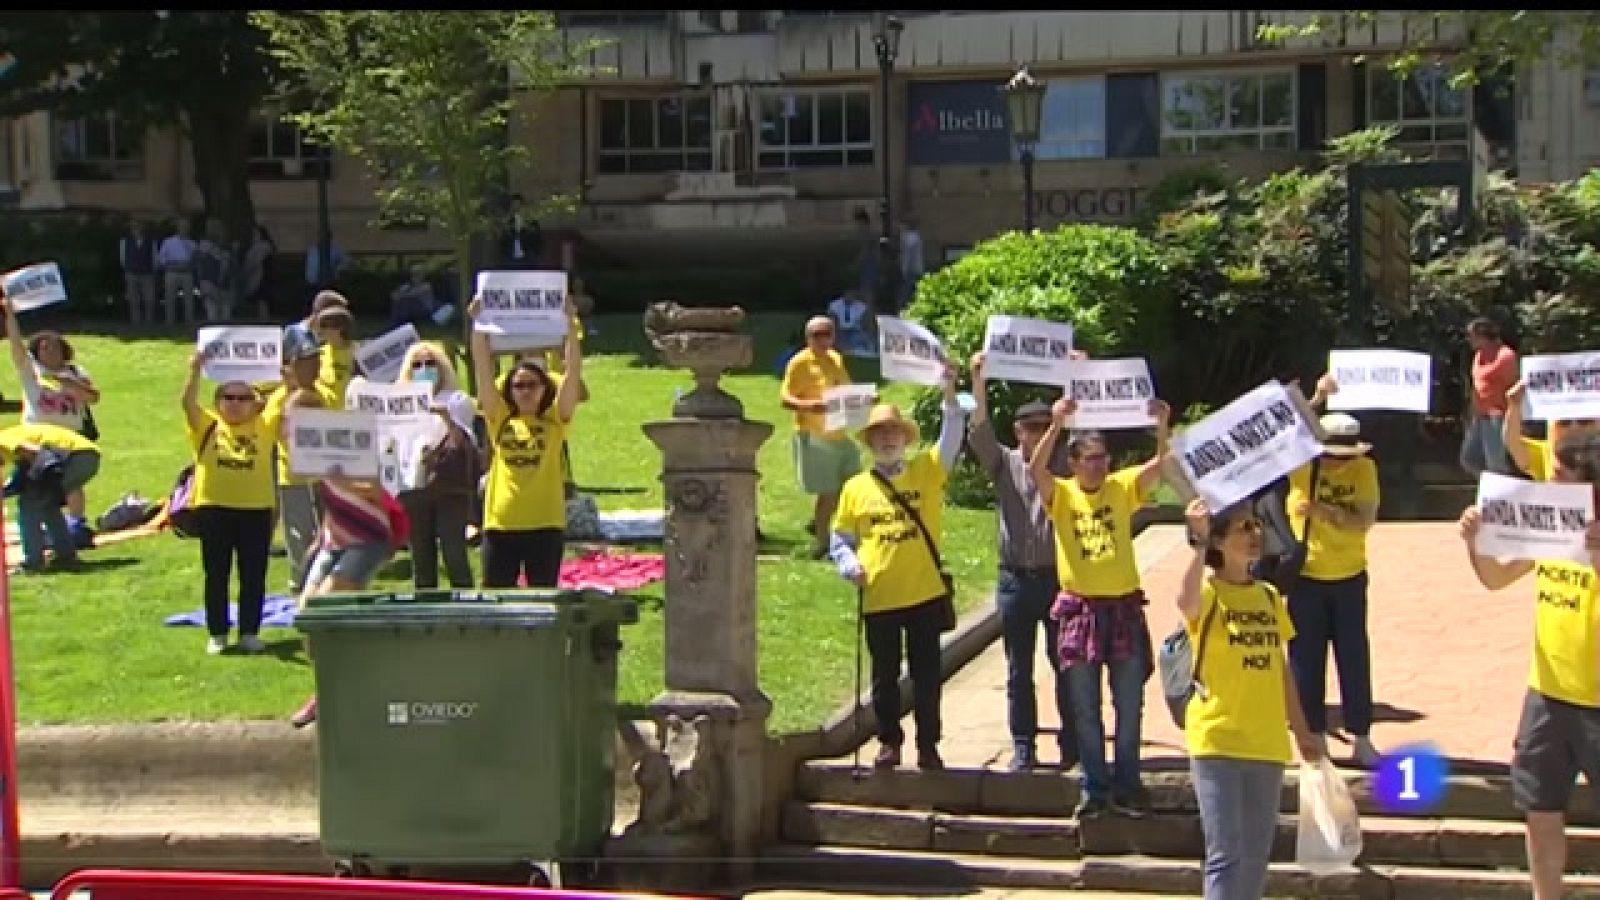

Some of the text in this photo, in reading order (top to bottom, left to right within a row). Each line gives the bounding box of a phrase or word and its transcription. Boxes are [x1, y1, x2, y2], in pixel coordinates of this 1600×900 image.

[913, 102, 1004, 131] Albella
[514, 289, 541, 310] NORTE
[1369, 366, 1401, 386] NORTE
[1104, 377, 1133, 400] NORTE
[1184, 434, 1238, 480] RONDA
[1228, 409, 1278, 455] NORTE
[1519, 503, 1557, 531] NORTE
[411, 701, 473, 718] OVIEDO
